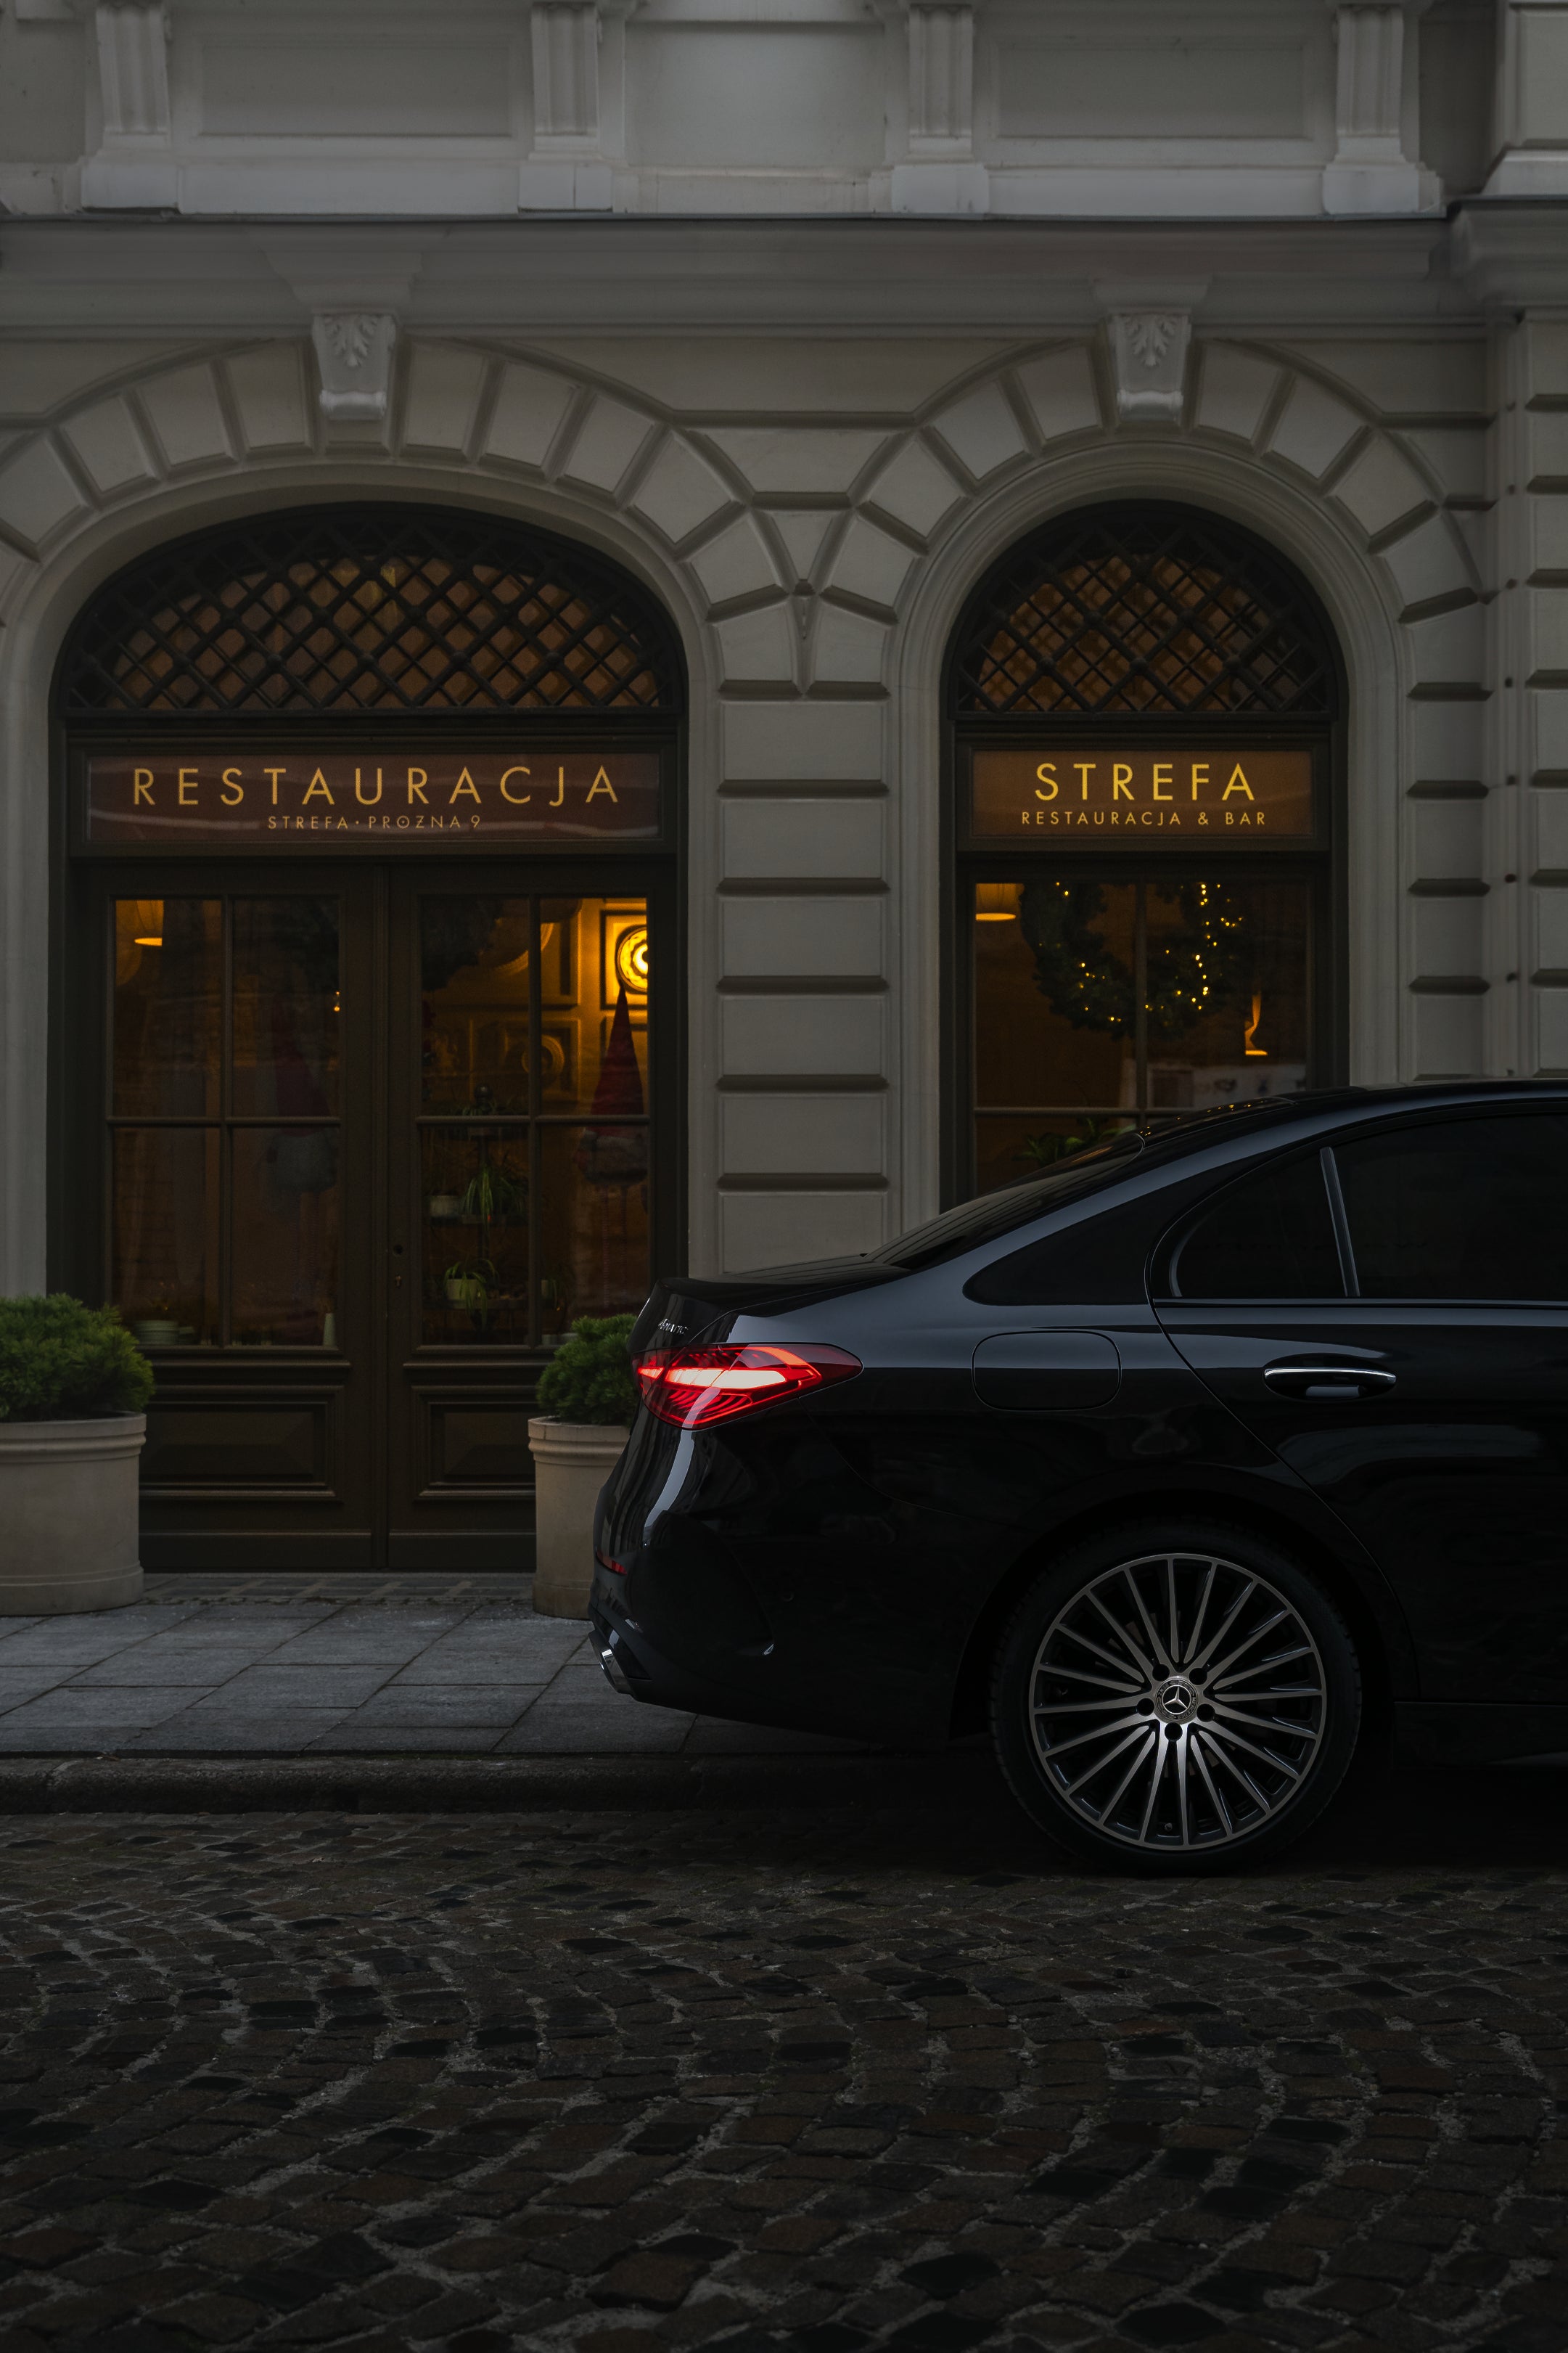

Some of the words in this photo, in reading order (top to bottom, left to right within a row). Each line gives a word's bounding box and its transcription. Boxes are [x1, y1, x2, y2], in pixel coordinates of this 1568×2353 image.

[132, 766, 619, 806] RESTAURACJA
[1035, 763, 1255, 801] STREFA
[268, 816, 349, 830] STREFA
[470, 814, 480, 829] 9
[1022, 811, 1181, 826] RESTAURACJA
[1197, 811, 1210, 825] &
[1225, 811, 1265, 825] BAR
